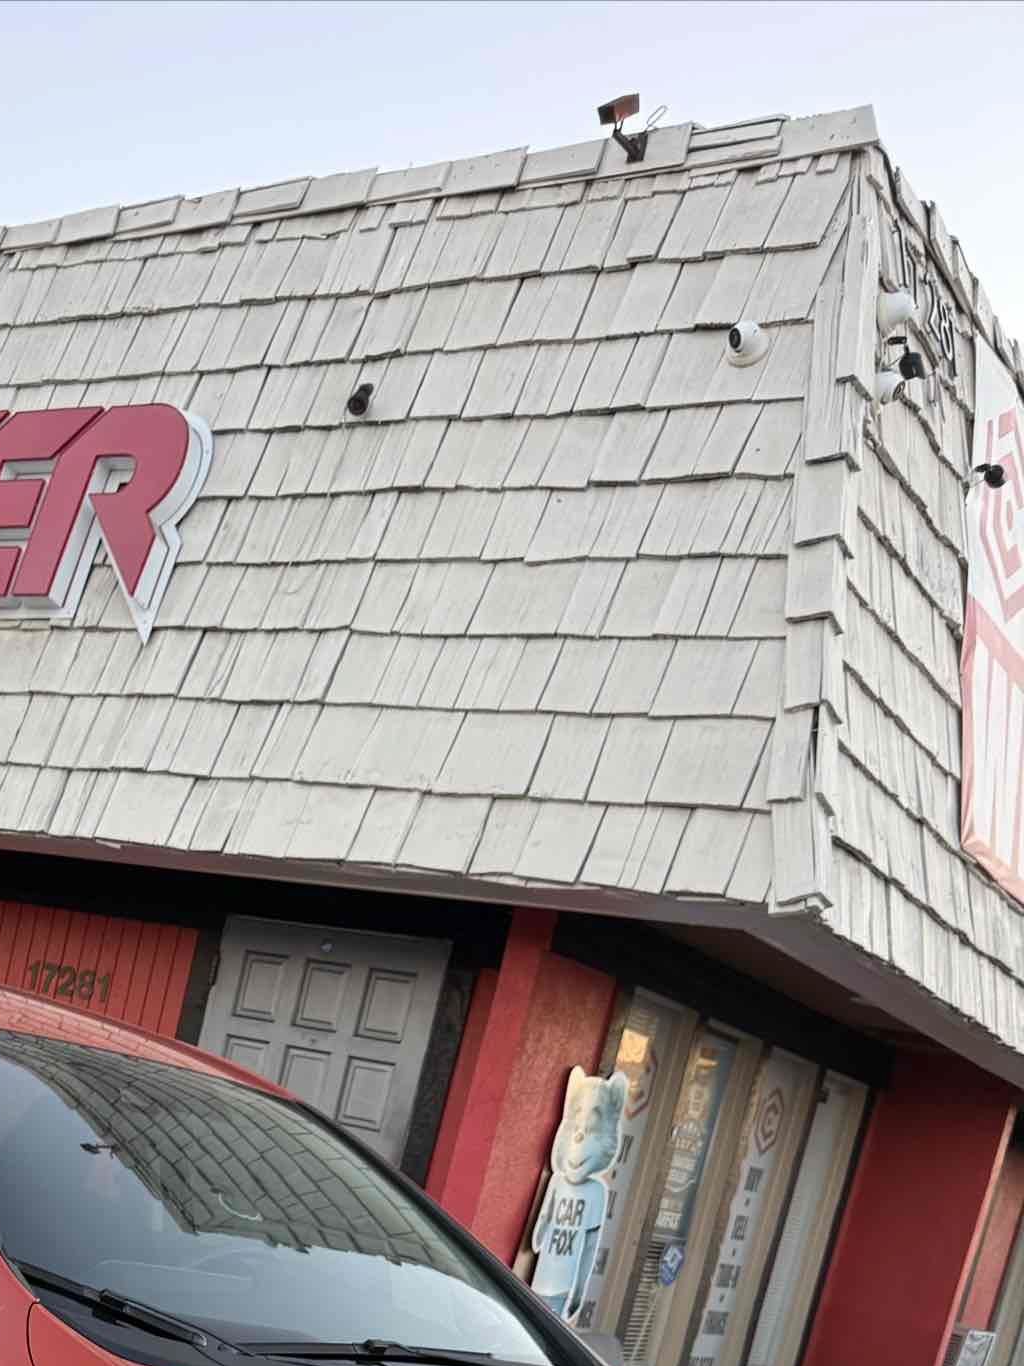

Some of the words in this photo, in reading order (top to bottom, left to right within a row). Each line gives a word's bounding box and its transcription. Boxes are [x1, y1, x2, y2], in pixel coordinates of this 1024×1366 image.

[29, 960, 110, 1003] 17281
[554, 1197, 586, 1227] CAR
[549, 1228, 579, 1257] FOX
